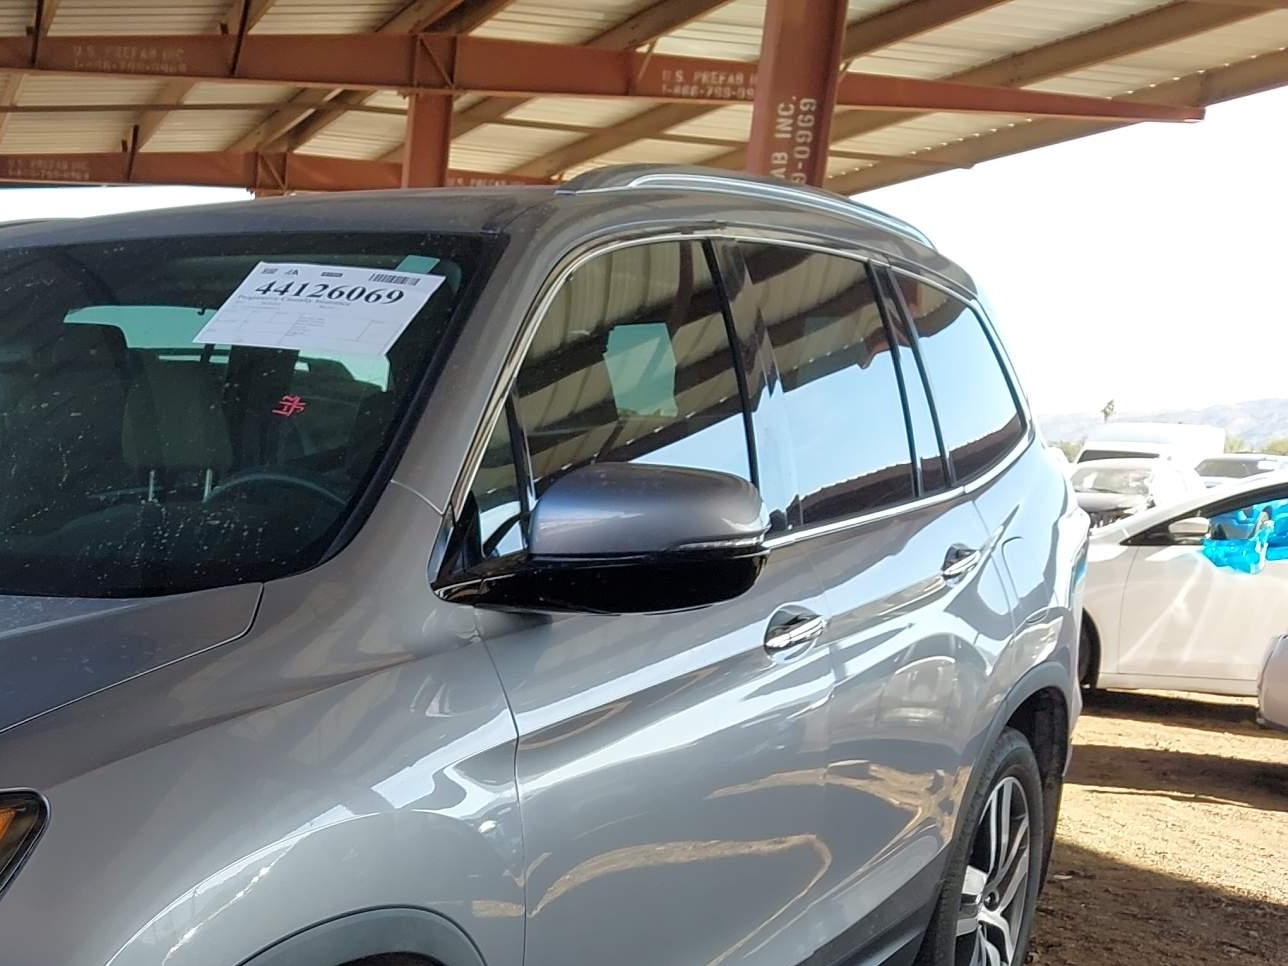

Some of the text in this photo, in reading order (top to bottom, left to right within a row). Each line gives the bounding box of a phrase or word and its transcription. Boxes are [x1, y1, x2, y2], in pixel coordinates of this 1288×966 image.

[693, 70, 745, 85] PREFAB
[776, 96, 797, 138] INC.
[255, 279, 405, 305] 44126069
